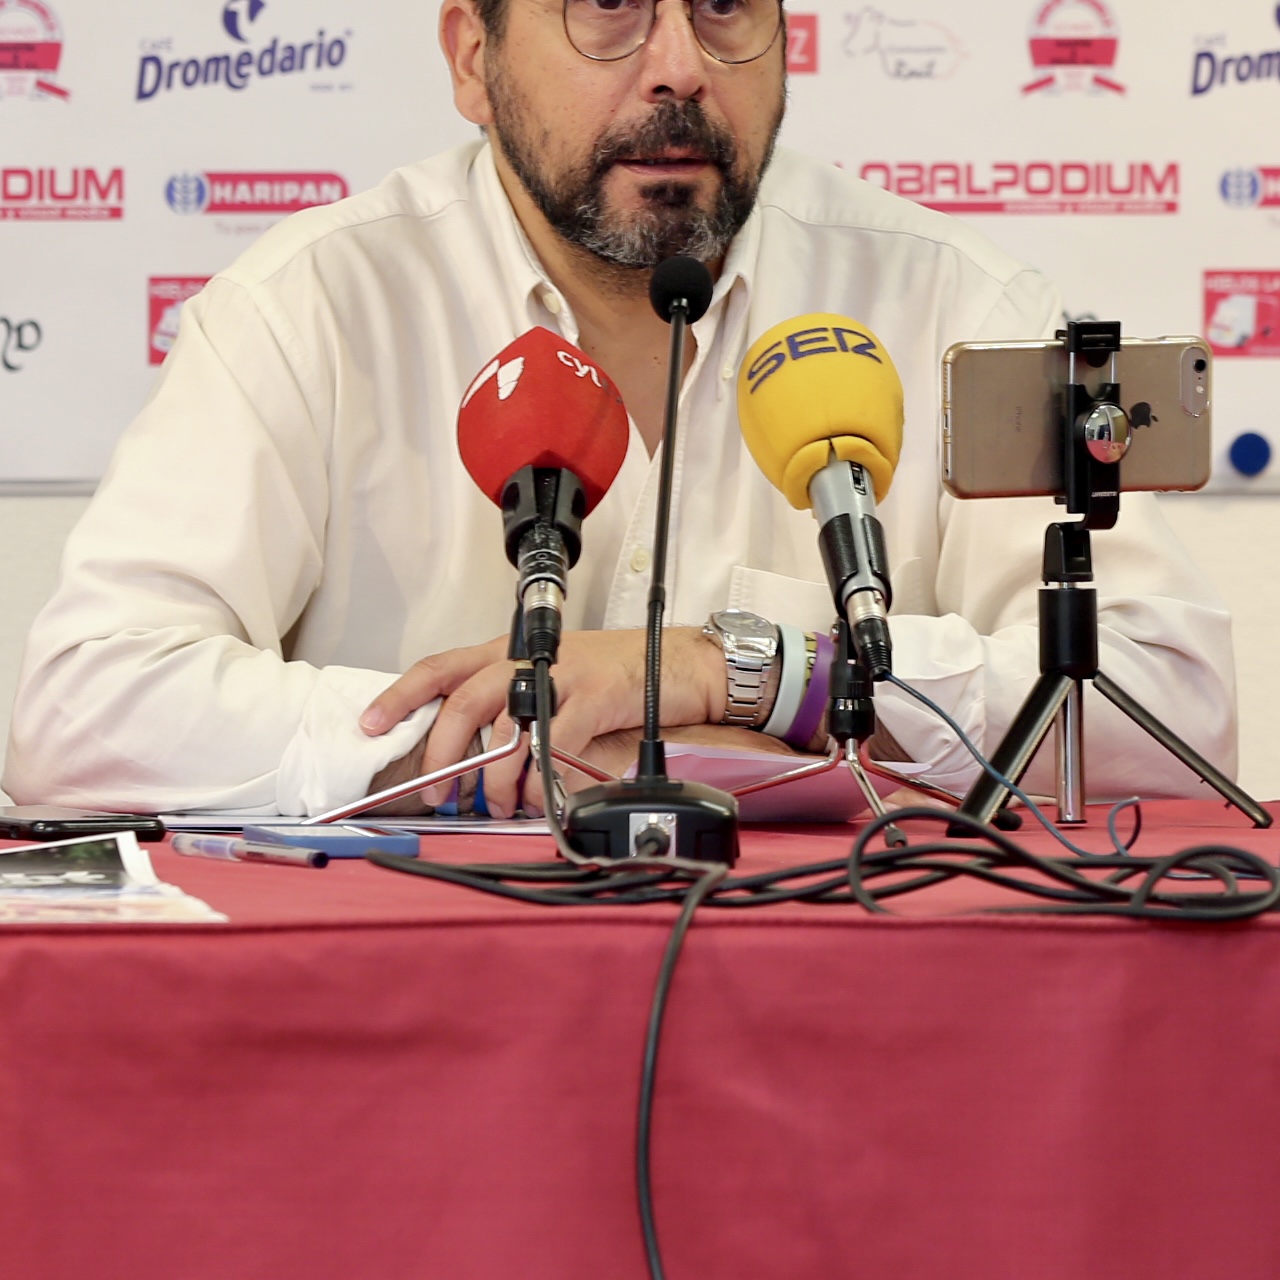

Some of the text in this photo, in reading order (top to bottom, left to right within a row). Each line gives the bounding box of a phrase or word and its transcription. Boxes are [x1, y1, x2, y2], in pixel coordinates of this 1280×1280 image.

[135, 29, 347, 102] Dromedario
[212, 182, 342, 205] HARIPAN
[747, 327, 884, 395] SER
